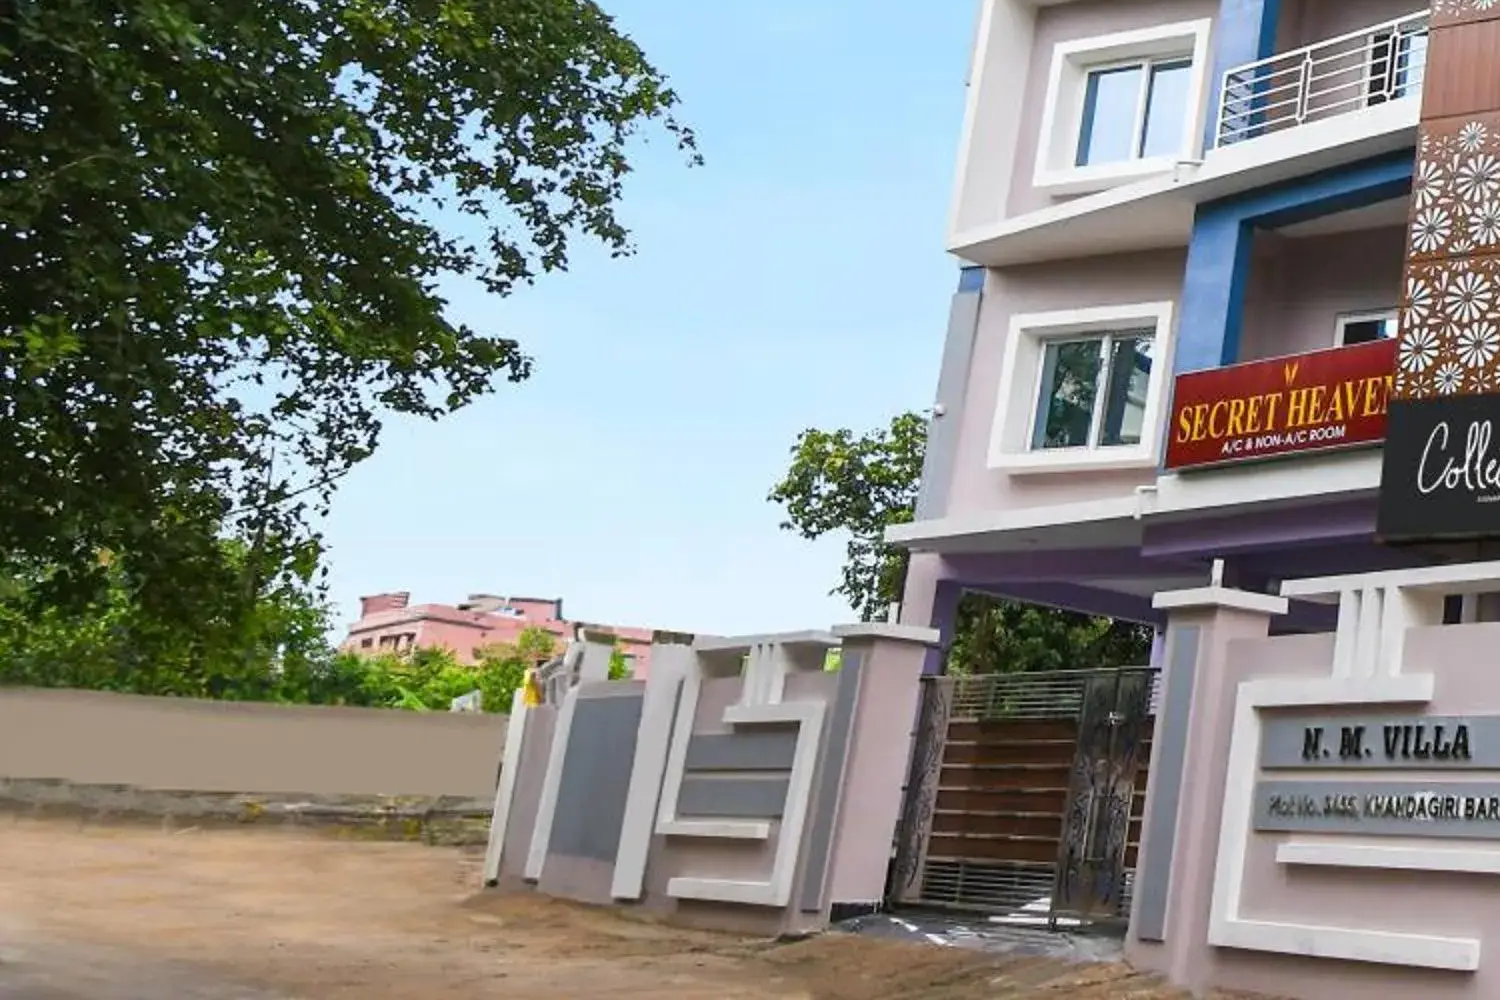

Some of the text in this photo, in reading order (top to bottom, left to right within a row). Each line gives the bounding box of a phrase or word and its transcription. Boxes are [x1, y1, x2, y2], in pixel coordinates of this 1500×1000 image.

[1177, 392, 1282, 443] SECRET
[1221, 439, 1242, 454] A/C
[1309, 425, 1345, 441] ROOM
[1383, 724, 1472, 761] VILLA
